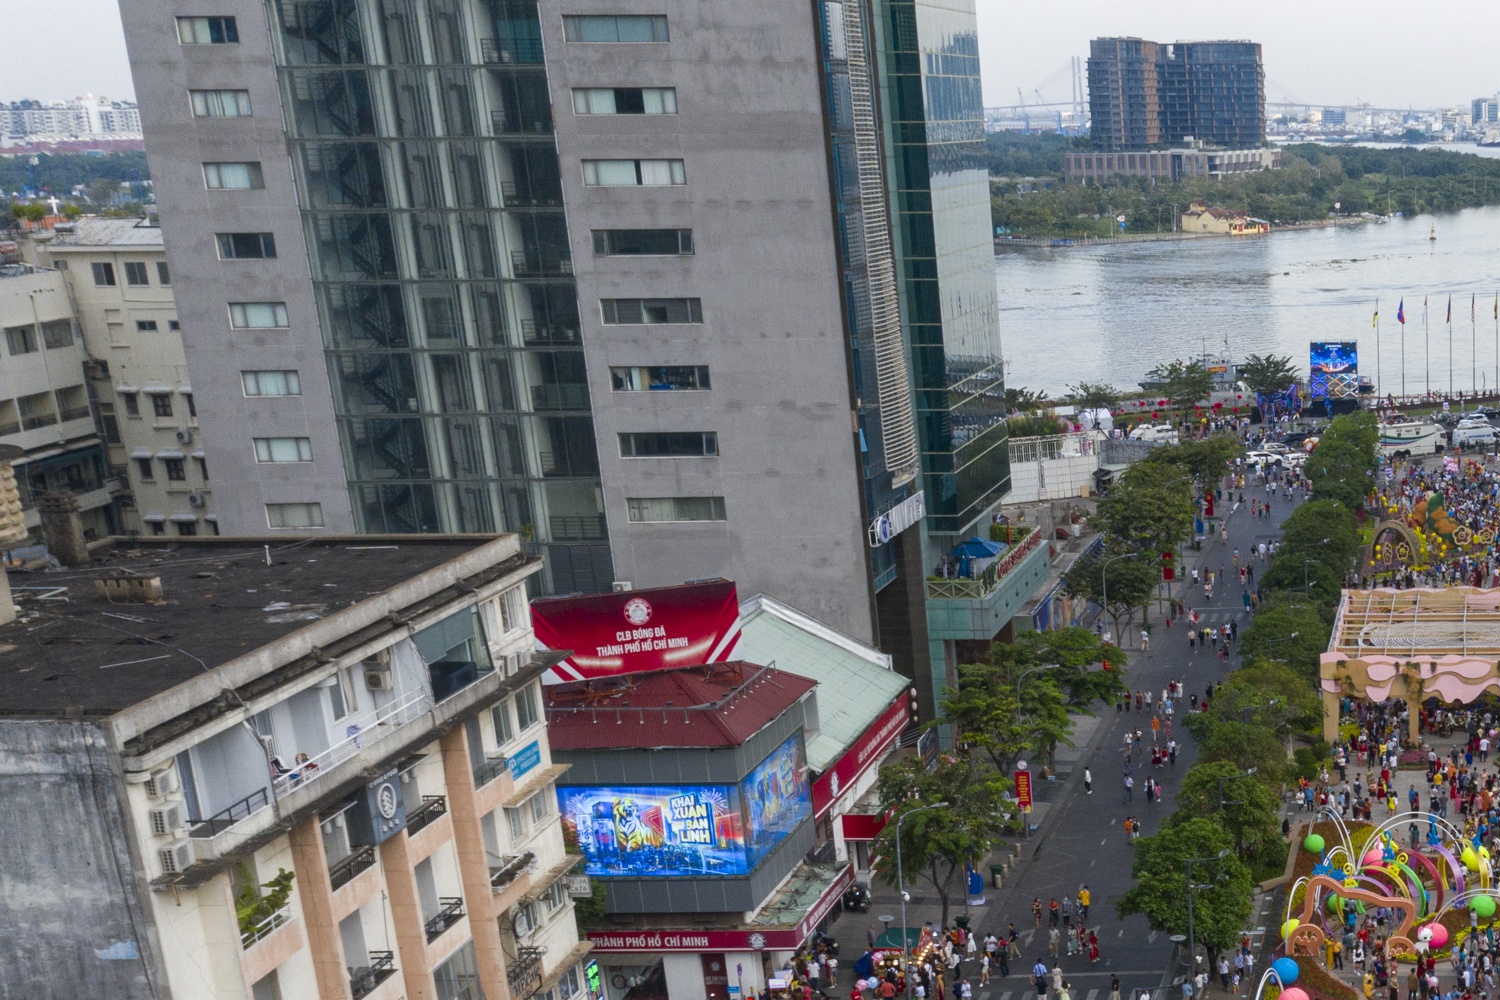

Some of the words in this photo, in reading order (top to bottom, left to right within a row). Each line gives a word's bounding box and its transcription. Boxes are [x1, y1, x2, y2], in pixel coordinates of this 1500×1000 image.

[616, 630, 632, 642] CLB
[632, 628, 654, 640] BÓNG
[654, 625, 666, 637] ĐÁ
[596, 644, 624, 657] THÀNH
[624, 640, 640, 654] PHỐ
[642, 639, 652, 651] HỒ
[653, 638, 667, 650] CHÍ
[668, 637, 688, 648] MINH
[671, 795, 695, 809] KHAI
[591, 935, 624, 947] THÀNH
[626, 934, 646, 947] PHỐ
[648, 934, 661, 947] HỒ
[664, 934, 680, 947] CHÍ
[683, 937, 709, 947] MINH
